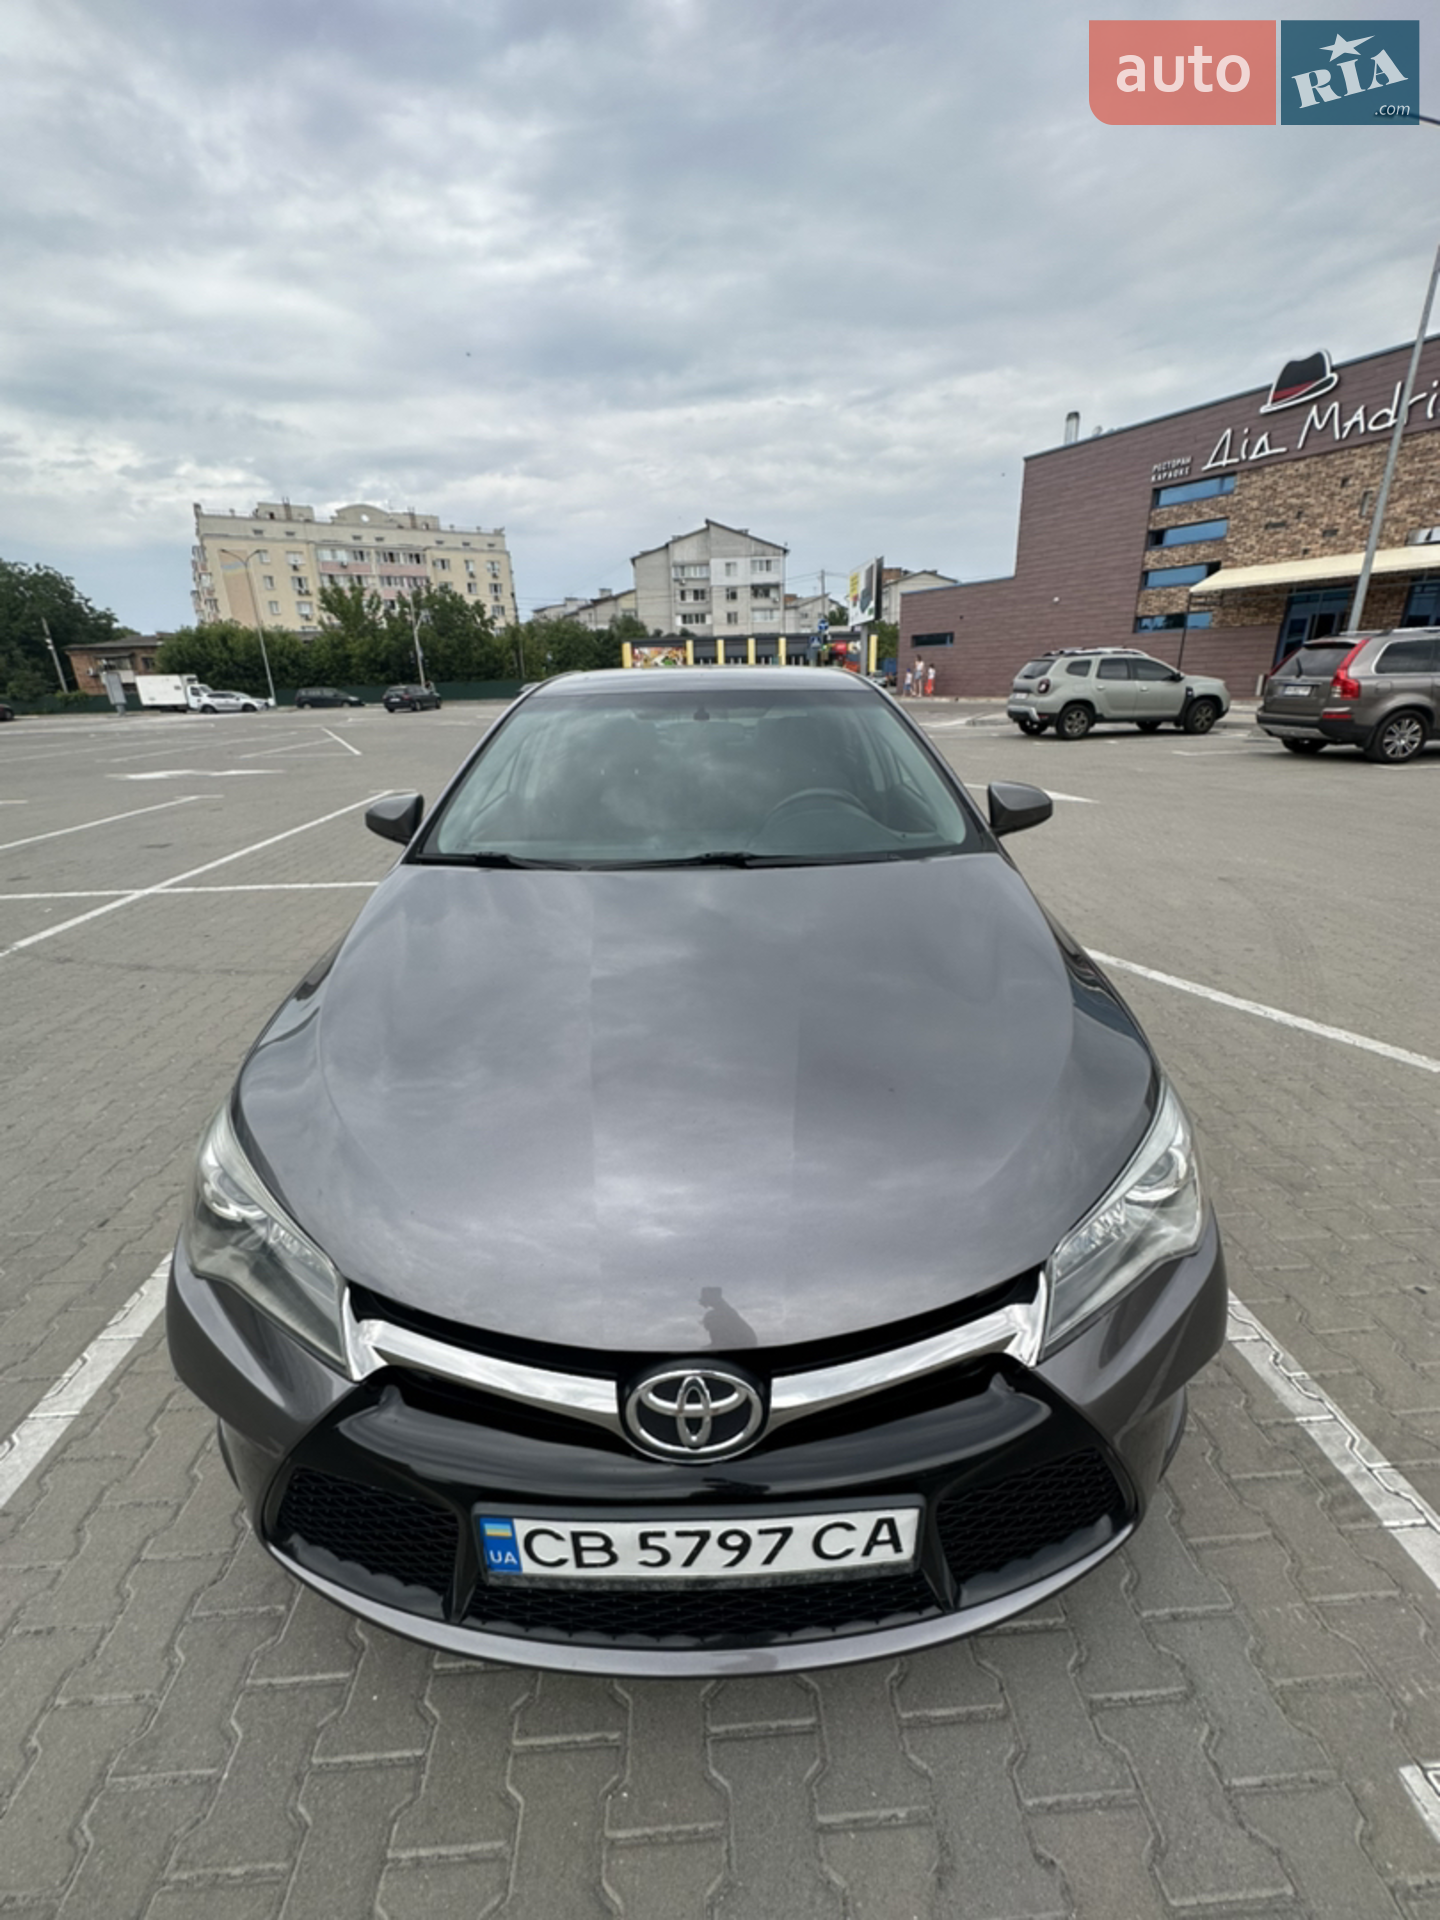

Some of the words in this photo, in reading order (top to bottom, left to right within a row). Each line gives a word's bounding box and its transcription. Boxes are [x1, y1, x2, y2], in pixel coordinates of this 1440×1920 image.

[489, 1550, 518, 1565] UA
[523, 1528, 619, 1569] CB
[638, 1526, 794, 1568] 5797
[811, 1517, 904, 1561] CA
